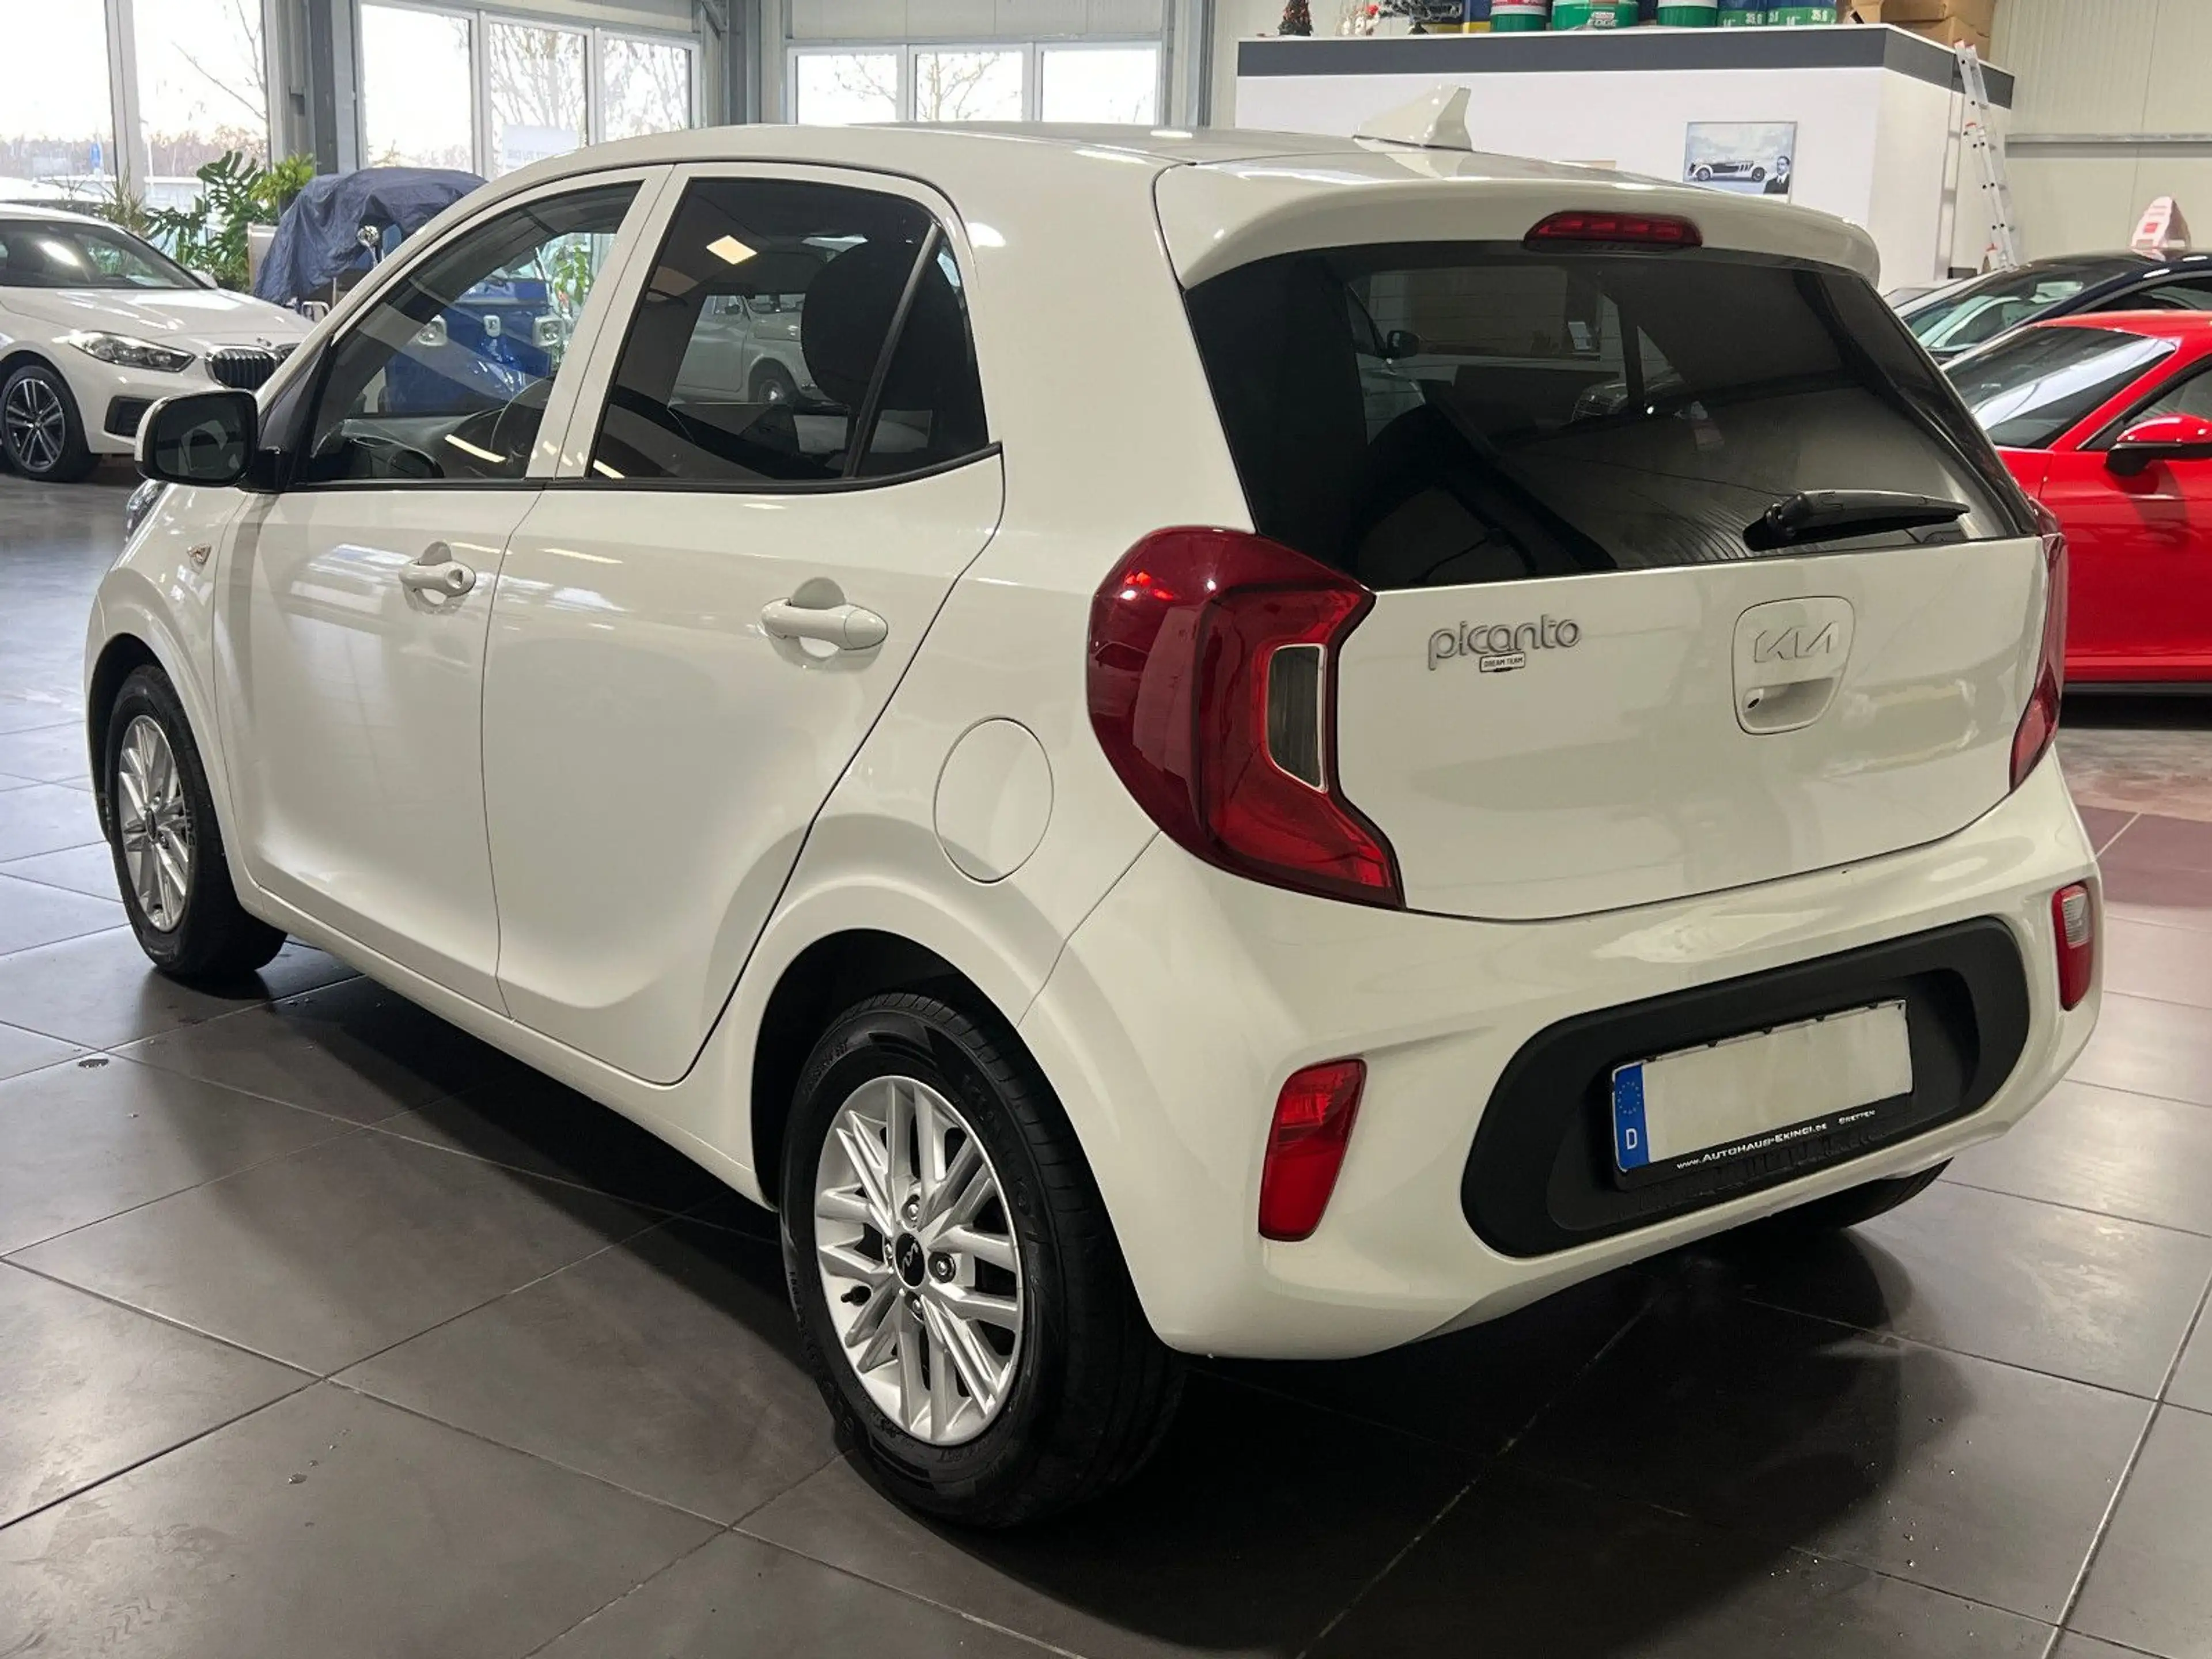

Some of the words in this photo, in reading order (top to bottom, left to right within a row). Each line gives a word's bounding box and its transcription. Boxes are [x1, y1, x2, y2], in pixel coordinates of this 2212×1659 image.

[1428, 613, 1582, 671] picanto
[1754, 620, 1839, 663] KIA
[1626, 1127, 1637, 1150] D
